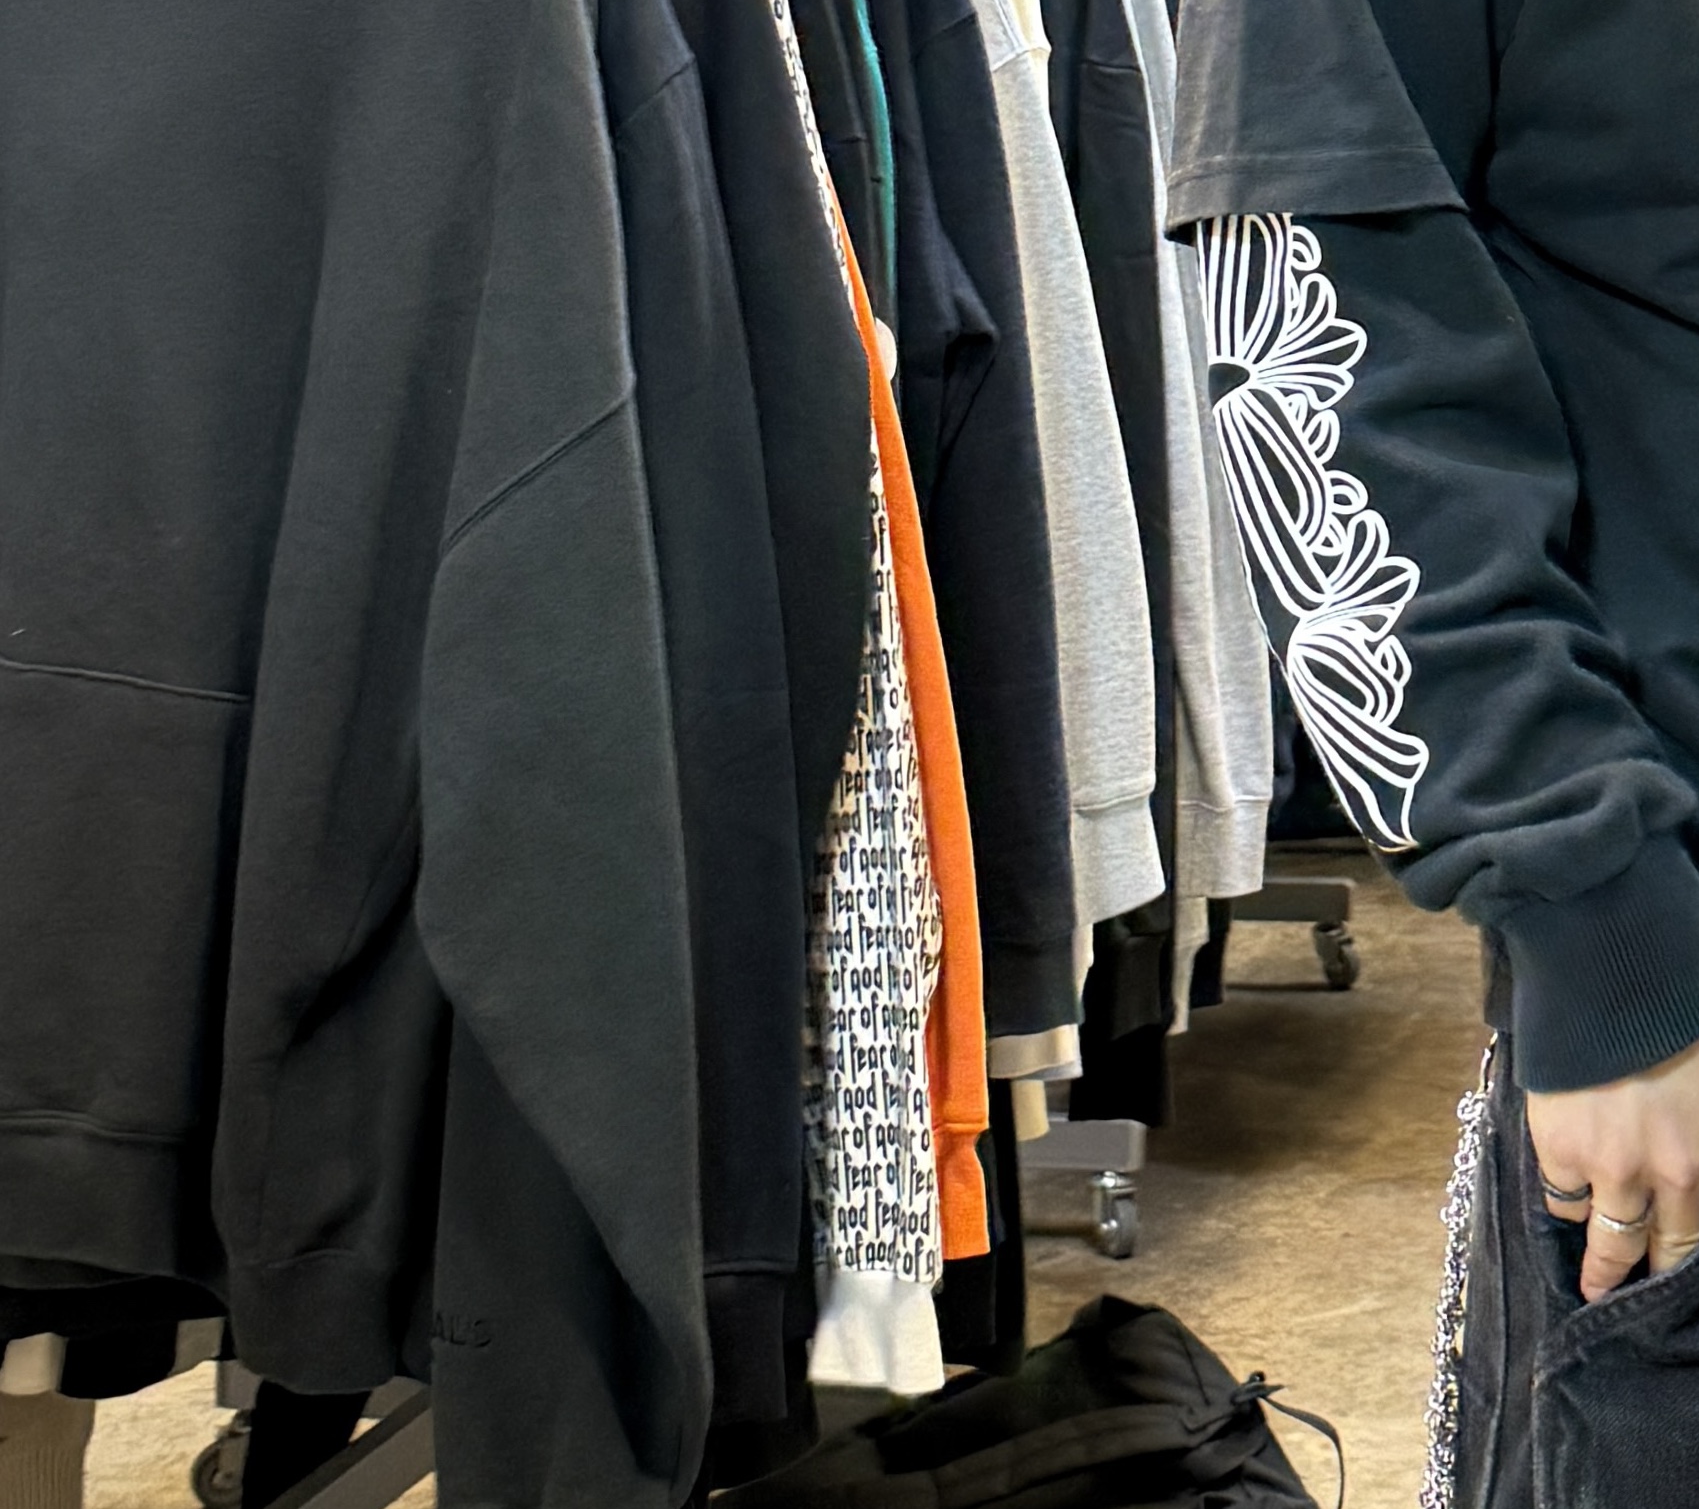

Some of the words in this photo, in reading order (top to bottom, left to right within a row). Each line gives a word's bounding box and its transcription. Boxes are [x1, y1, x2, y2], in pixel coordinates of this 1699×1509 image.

[850, 952, 883, 1003] god
[860, 991, 879, 1041] of
[850, 1033, 886, 1083] fear
[844, 1070, 877, 1123] god
[852, 1112, 872, 1161] of
[844, 1152, 882, 1202] fear
[838, 1191, 868, 1243] god
